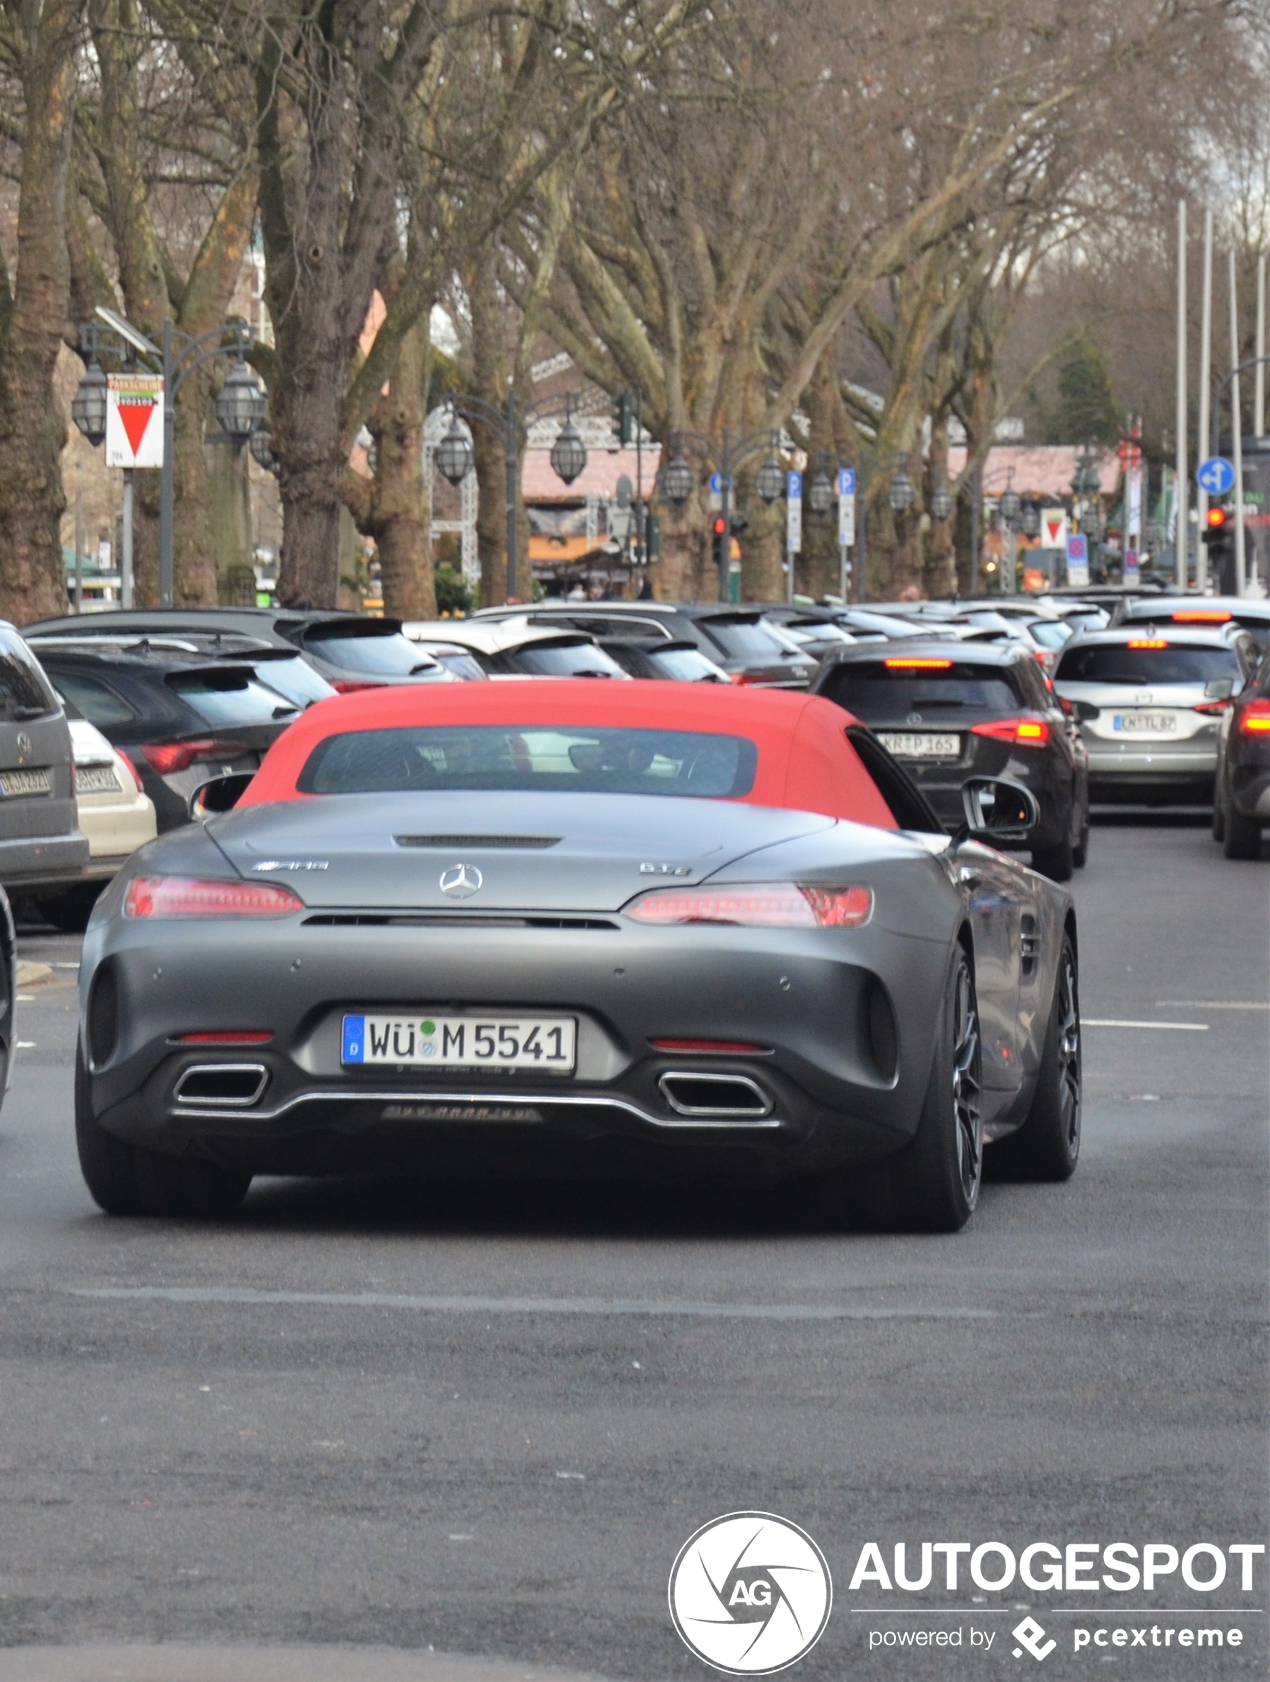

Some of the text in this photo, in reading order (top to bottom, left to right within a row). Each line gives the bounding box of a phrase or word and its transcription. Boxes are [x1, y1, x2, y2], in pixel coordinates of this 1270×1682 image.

[791, 475, 799, 494] P
[842, 472, 852, 493] P
[914, 738, 923, 751] P
[928, 738, 953, 751] 165
[370, 1023, 415, 1057] WÜ
[442, 1024, 465, 1057] M
[474, 1025, 567, 1060] 5541
